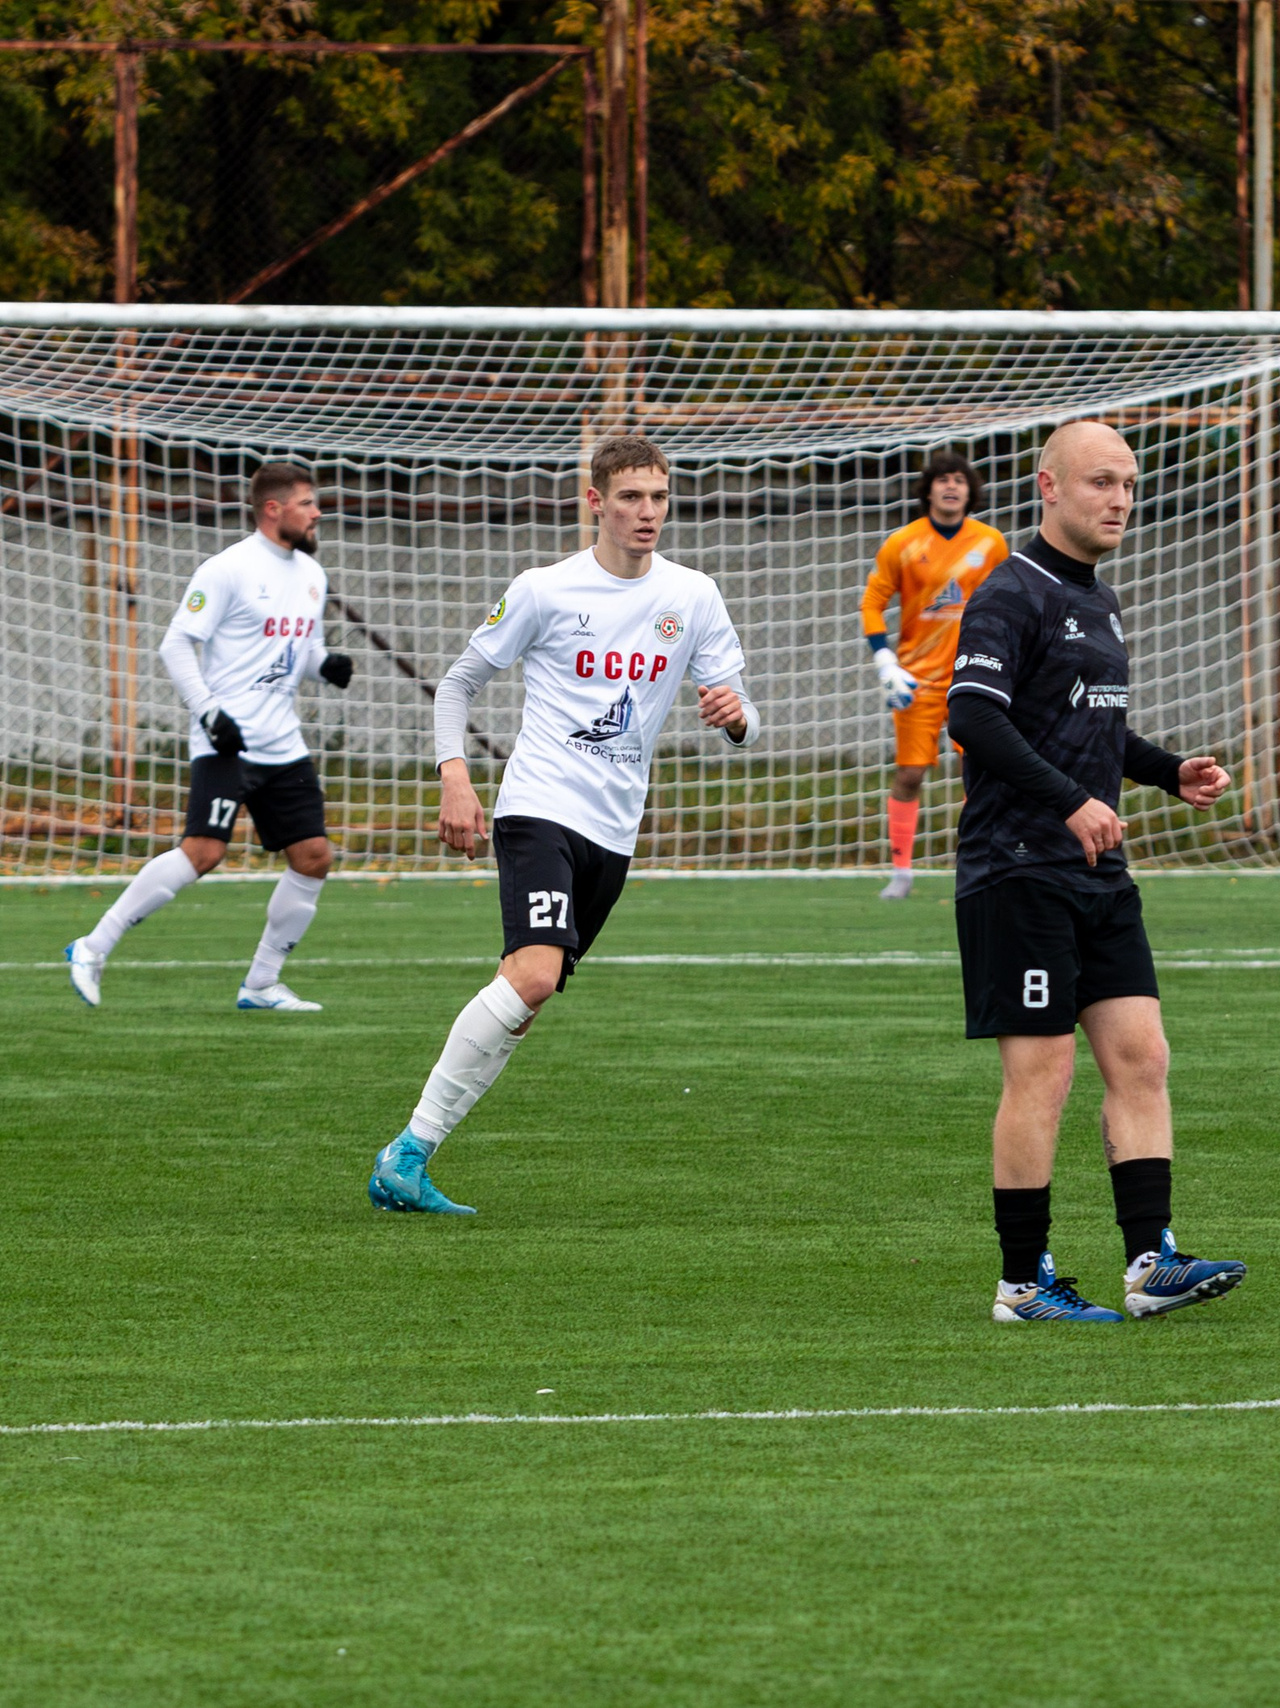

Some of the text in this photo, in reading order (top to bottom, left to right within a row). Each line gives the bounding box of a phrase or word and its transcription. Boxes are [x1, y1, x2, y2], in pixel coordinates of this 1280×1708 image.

[576, 650, 668, 682] СССР
[1086, 693, 1128, 708] TATNE
[209, 797, 236, 828] 17
[529, 890, 568, 929] 27
[1023, 969, 1049, 1008] 8
